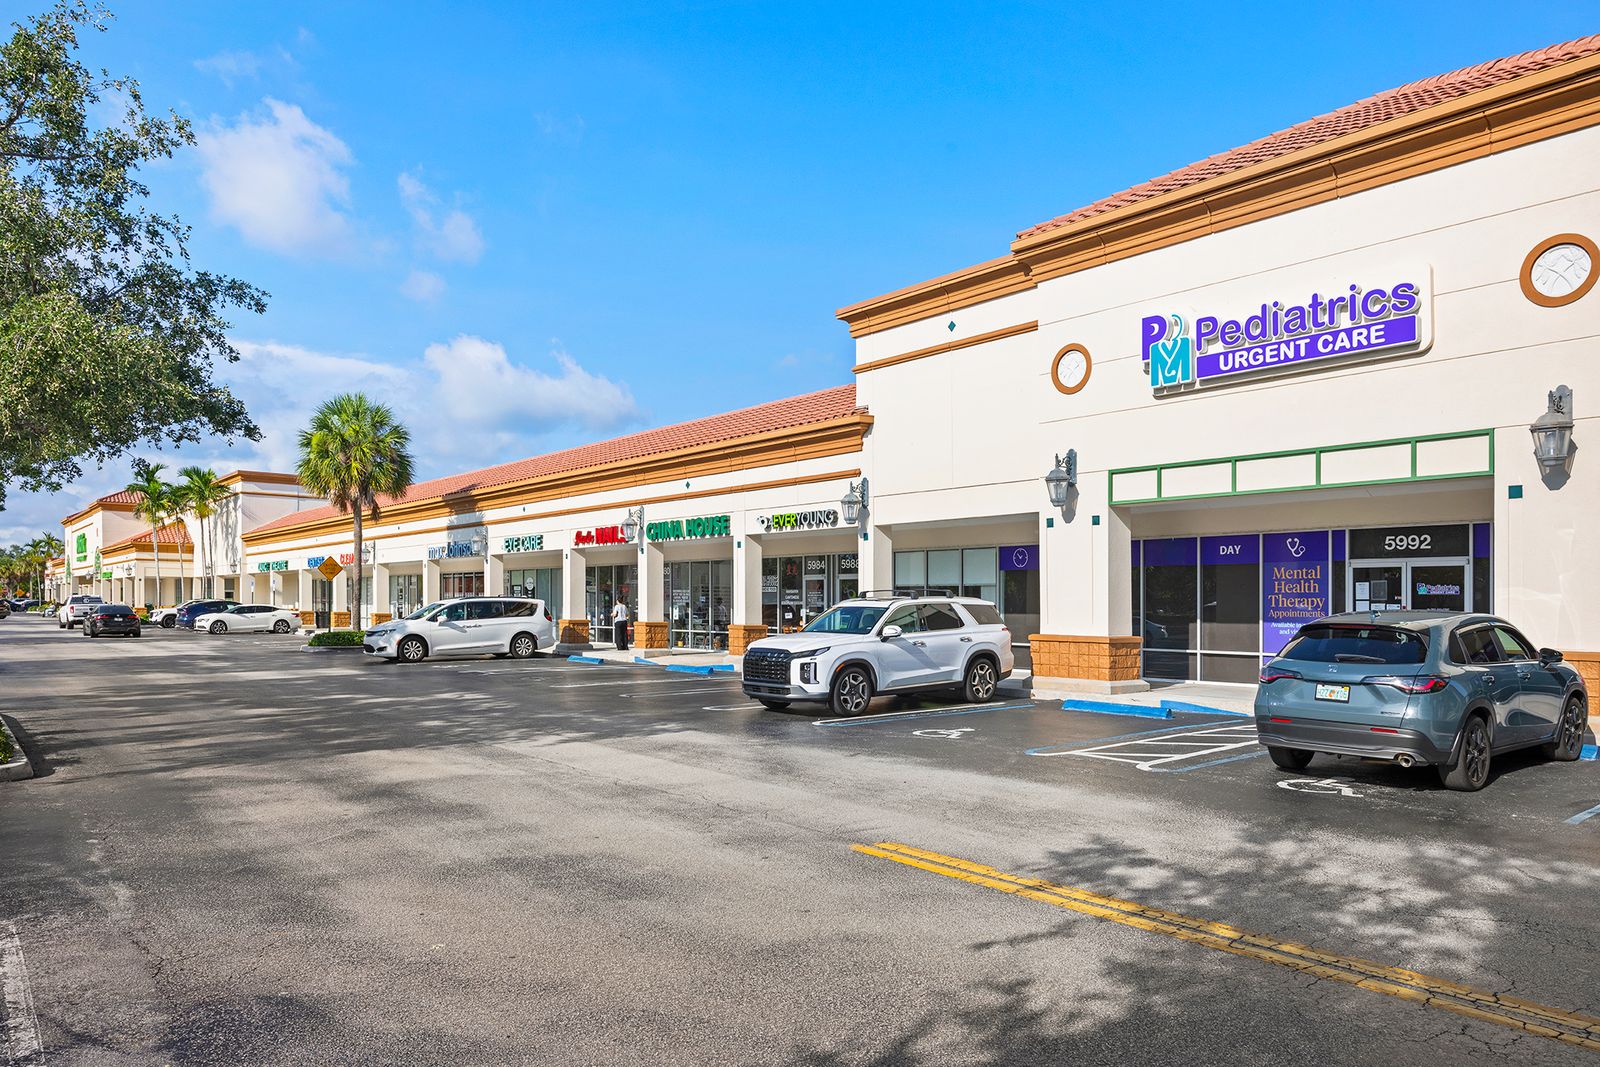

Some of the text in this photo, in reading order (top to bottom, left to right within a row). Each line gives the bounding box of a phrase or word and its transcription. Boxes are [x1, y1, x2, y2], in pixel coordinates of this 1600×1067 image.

[1195, 281, 1418, 351] Pediatrics
[1218, 324, 1387, 372] URGENT CARE
[646, 515, 731, 541] CHINA HOUSE
[503, 534, 543, 553] EYE CARE
[1219, 544, 1242, 556] DAY
[1384, 534, 1432, 551] 5992
[1272, 565, 1321, 580] Mental
[1274, 580, 1320, 594] Health
[1267, 594, 1326, 611] Therapy
[1268, 609, 1326, 618] Appointments
